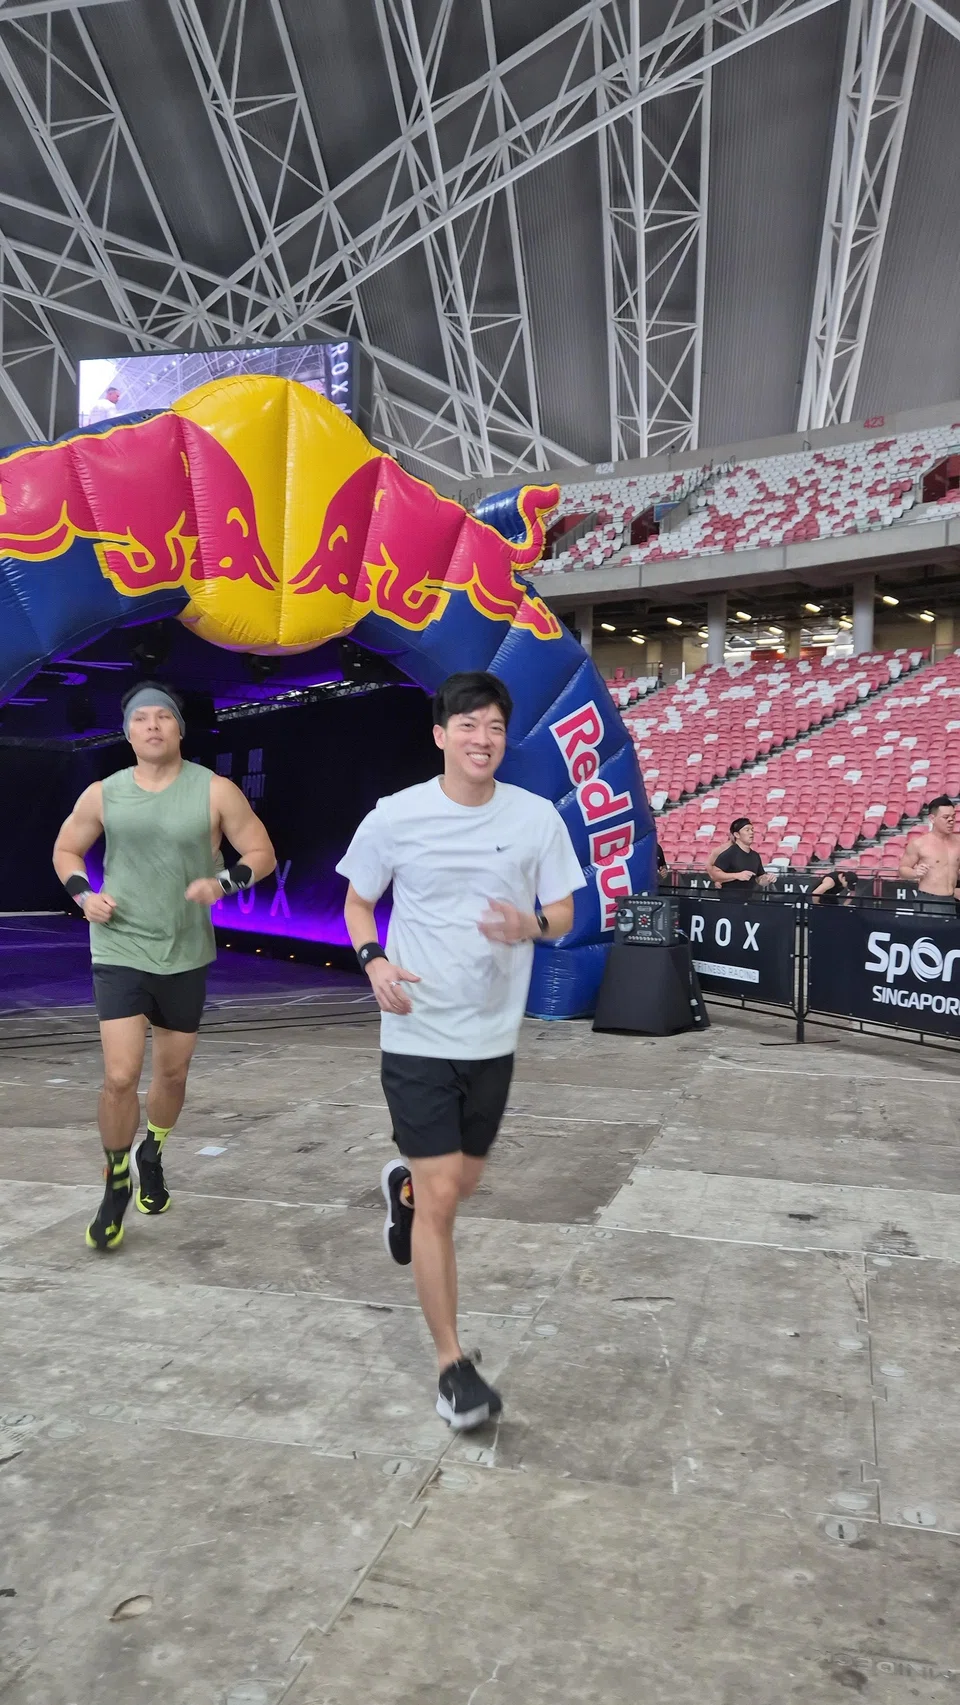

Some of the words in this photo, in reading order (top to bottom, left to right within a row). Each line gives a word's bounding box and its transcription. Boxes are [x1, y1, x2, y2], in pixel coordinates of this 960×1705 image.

[331, 341, 349, 396] ROX
[863, 416, 885, 429] 423
[595, 462, 615, 474] 424
[550, 702, 632, 825] Red
[690, 914, 761, 952] ROX
[697, 962, 726, 976] FITNESS
[728, 967, 757, 982] RACING
[872, 985, 960, 1016] SINGAPOR
